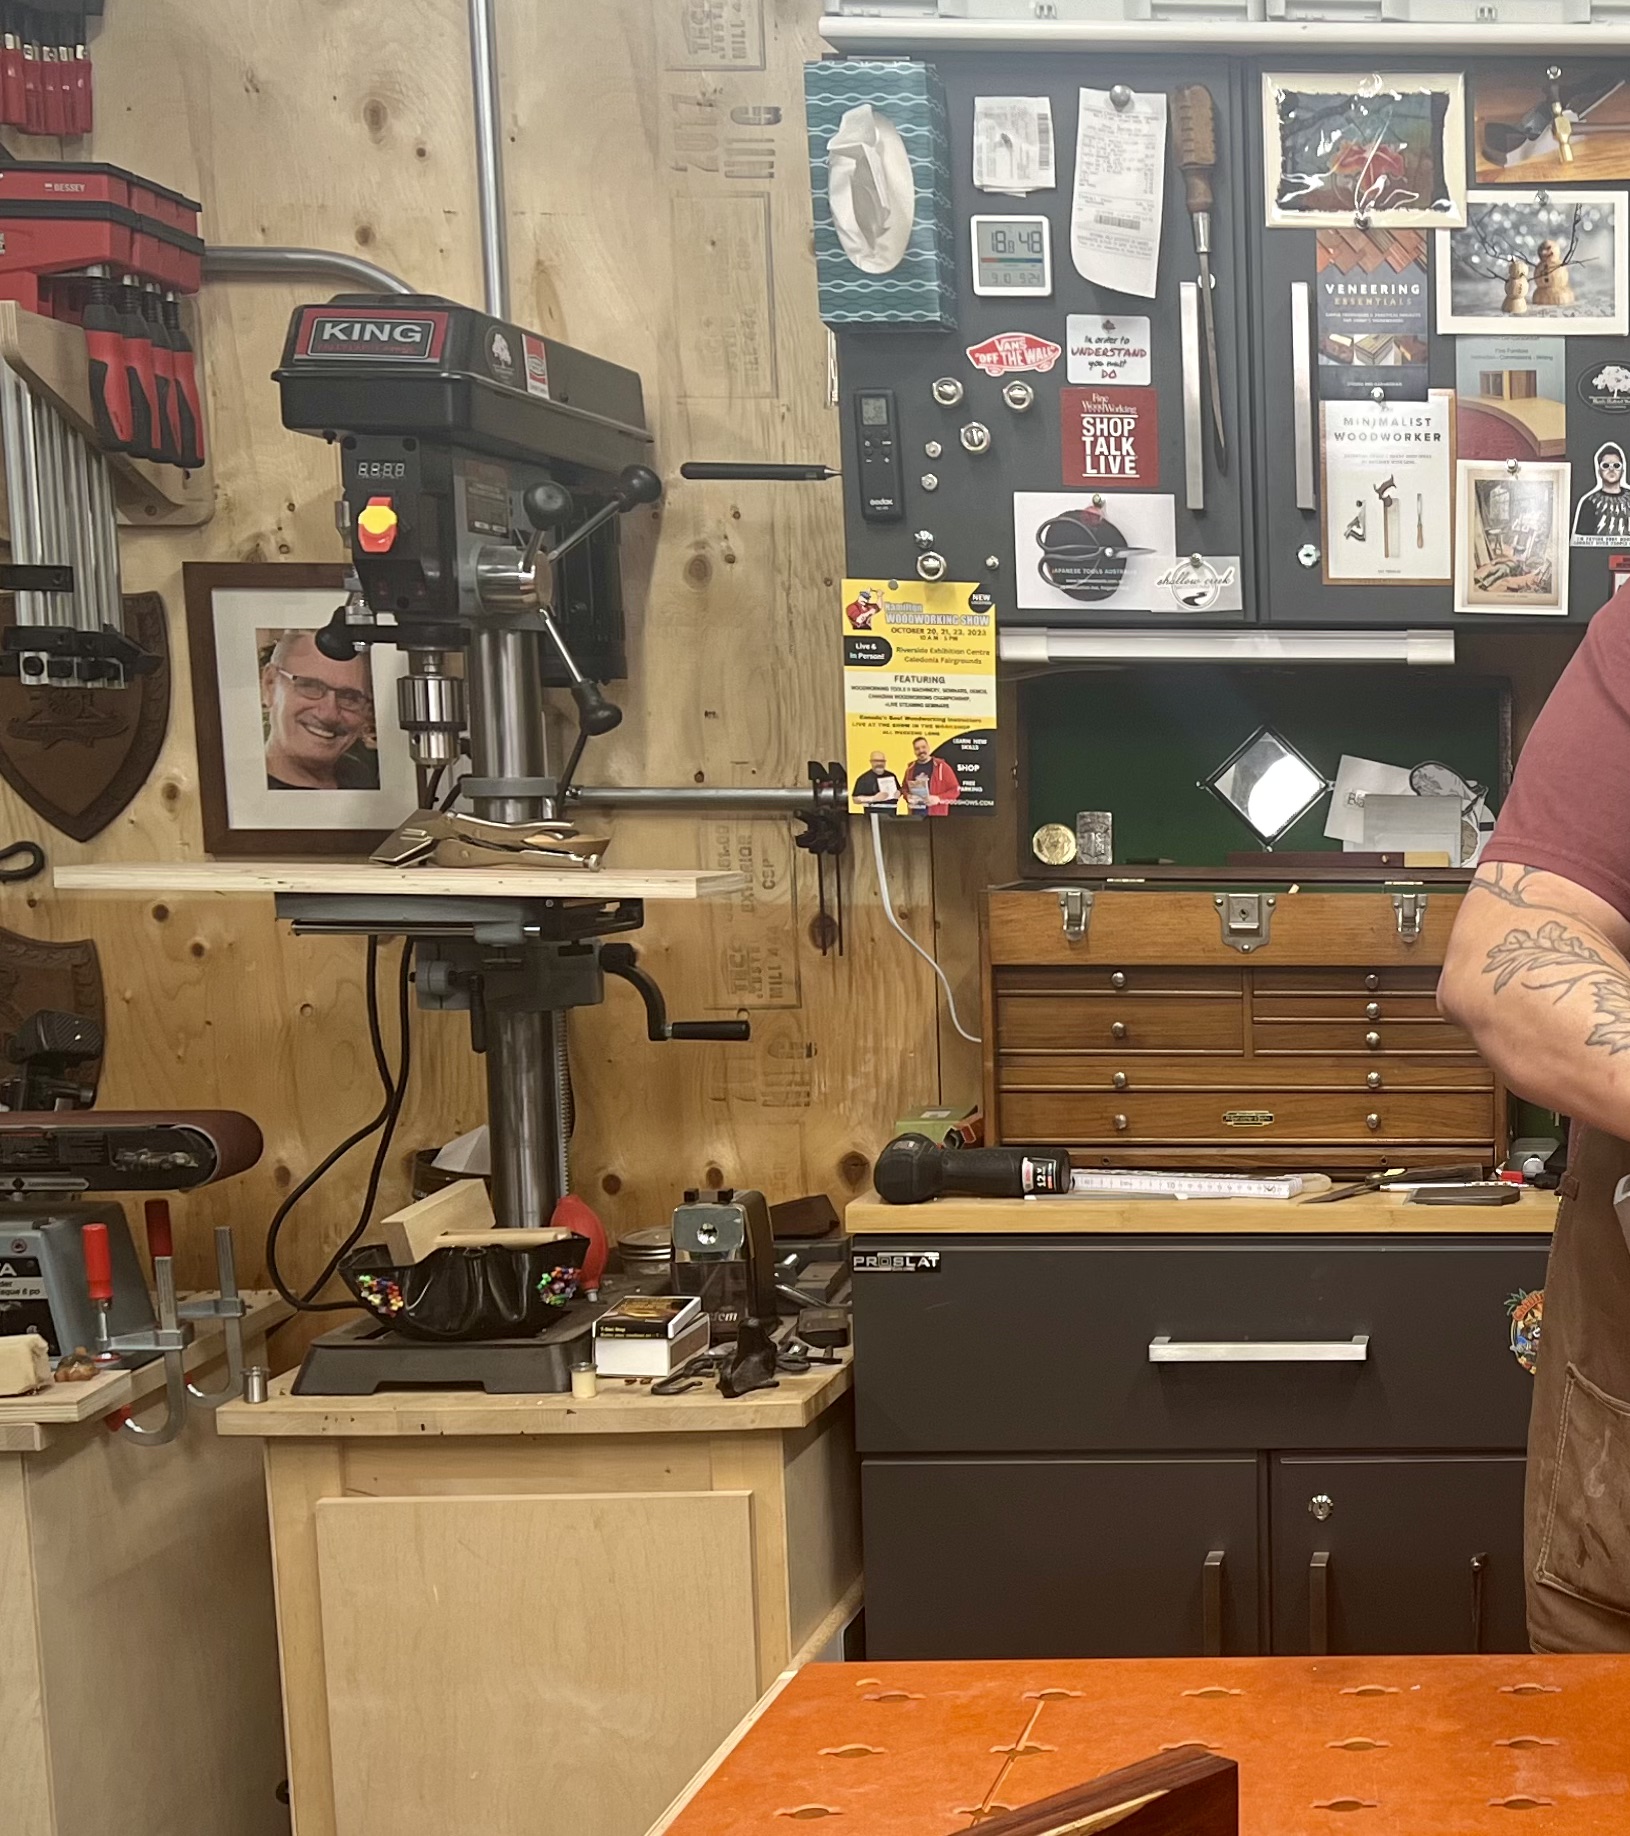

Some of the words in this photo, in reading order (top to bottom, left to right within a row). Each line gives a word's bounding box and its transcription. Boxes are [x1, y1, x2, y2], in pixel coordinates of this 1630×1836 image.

[54, 183, 86, 193] BESSEY
[1325, 283, 1420, 295] VENEERING
[1334, 297, 1412, 307] ESSENTIALS
[322, 322, 422, 343] KING
[994, 336, 1027, 351] VANS
[1119, 335, 1130, 345] to
[1000, 350, 1024, 366] THE
[1070, 347, 1147, 358] UNDERSTAND
[1088, 361, 1105, 370] you
[1101, 370, 1118, 379] DO
[1082, 417, 1136, 437] SHOP
[1343, 417, 1432, 429] MINIMALIST
[1333, 432, 1442, 442] WOODWORKER
[1082, 437, 1136, 456] TALK
[1085, 456, 1137, 475] LIVE
[972, 593, 991, 601] NEW
[885, 613, 960, 625] WOODWORKING
[960, 614, 990, 626] SHOW
[890, 627, 924, 635] OCTOBER
[855, 642, 871, 650] Live
[904, 655, 939, 664] Caledonia
[940, 656, 982, 666] Fairgrounds
[894, 675, 946, 684] FEATURING
[956, 763, 980, 772] SHOP
[853, 1253, 940, 1268] PROSLAT
